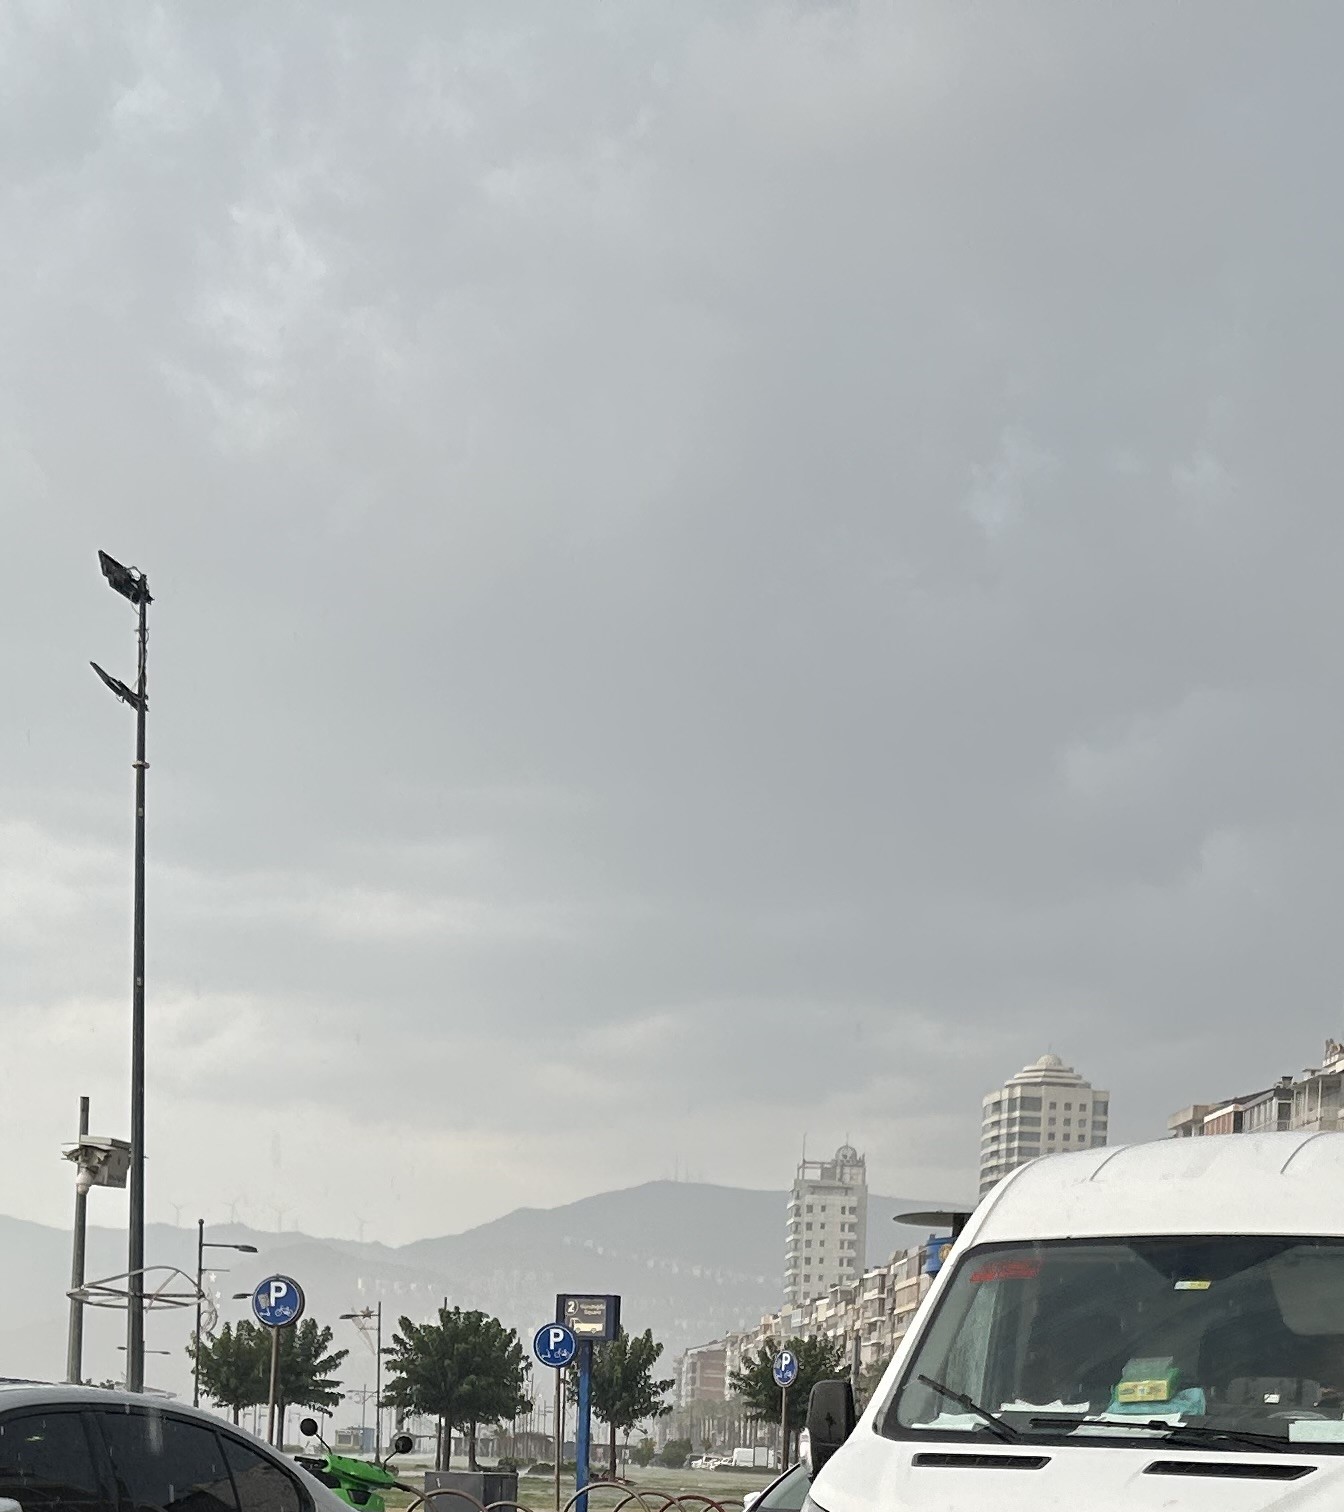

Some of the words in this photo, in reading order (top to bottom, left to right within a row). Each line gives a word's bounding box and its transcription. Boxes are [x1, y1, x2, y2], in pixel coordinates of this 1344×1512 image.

[270, 1281, 287, 1307] P
[567, 1301, 575, 1313] 2
[549, 1329, 564, 1350] P
[782, 1353, 791, 1371] P
